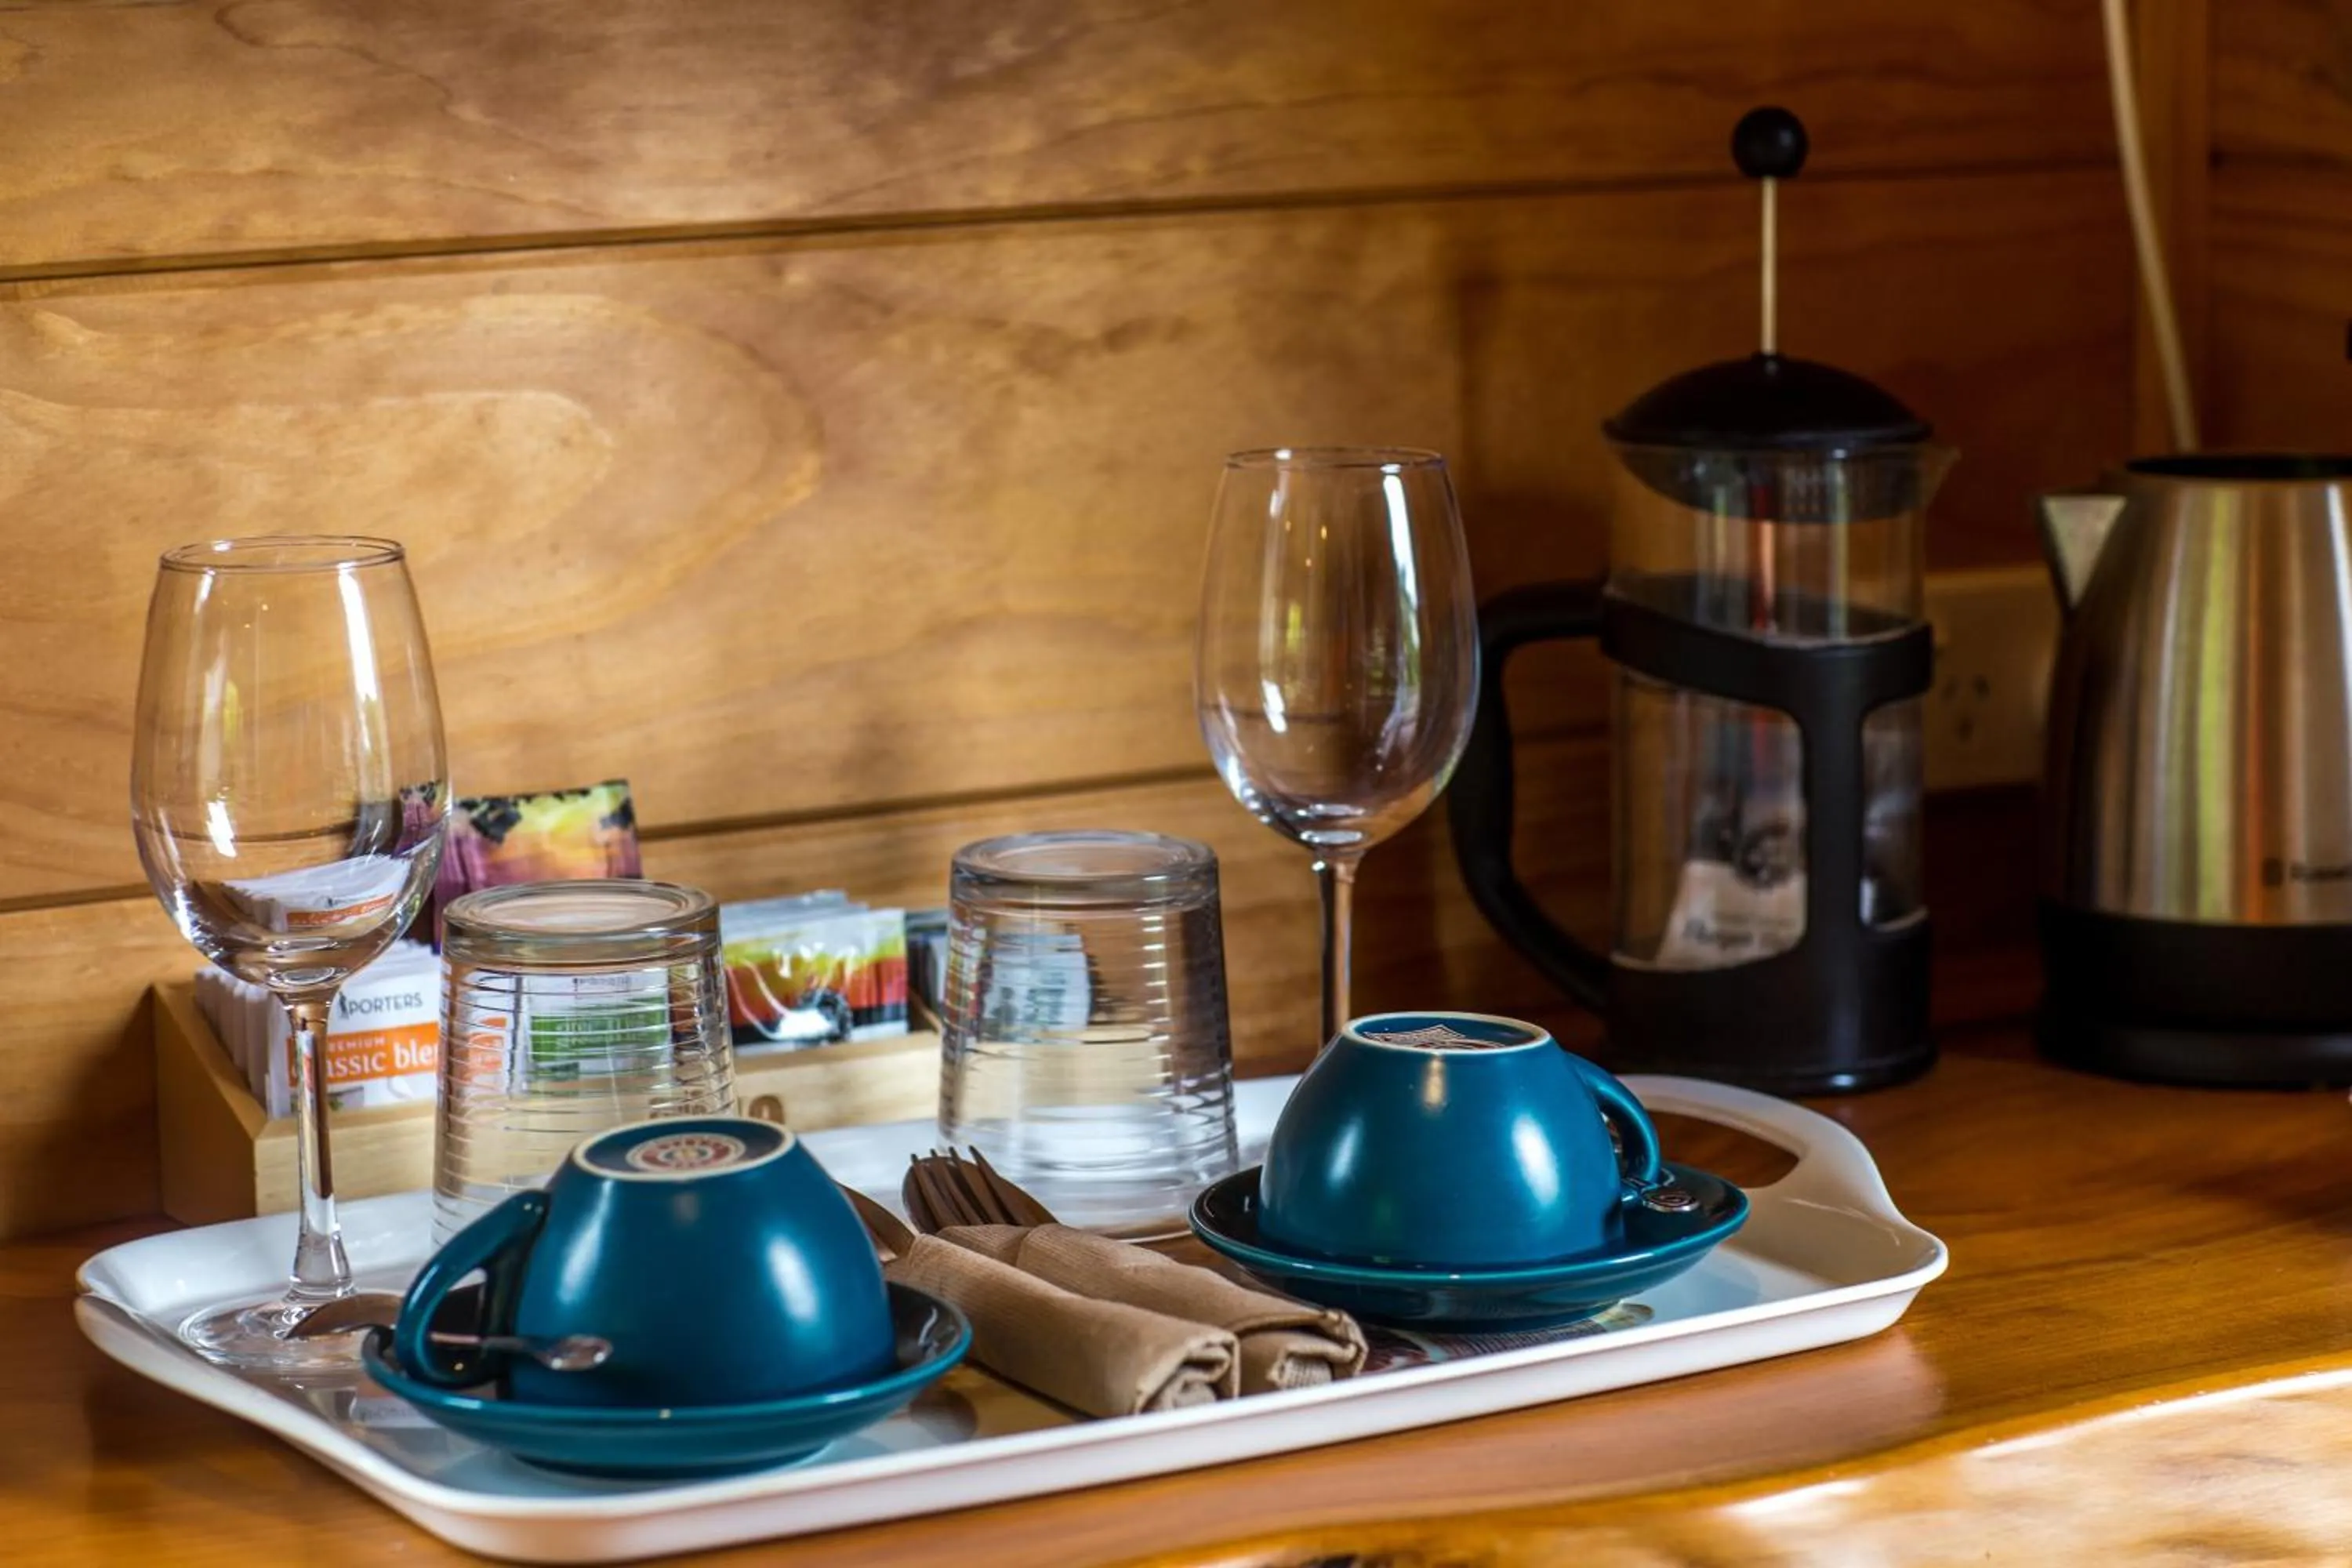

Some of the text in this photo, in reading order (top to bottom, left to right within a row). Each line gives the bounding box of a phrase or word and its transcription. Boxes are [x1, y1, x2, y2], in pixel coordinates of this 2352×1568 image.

[349, 993, 423, 1014] PORTERS
[328, 1036, 386, 1052] REMIUM
[393, 1038, 439, 1069] ble
